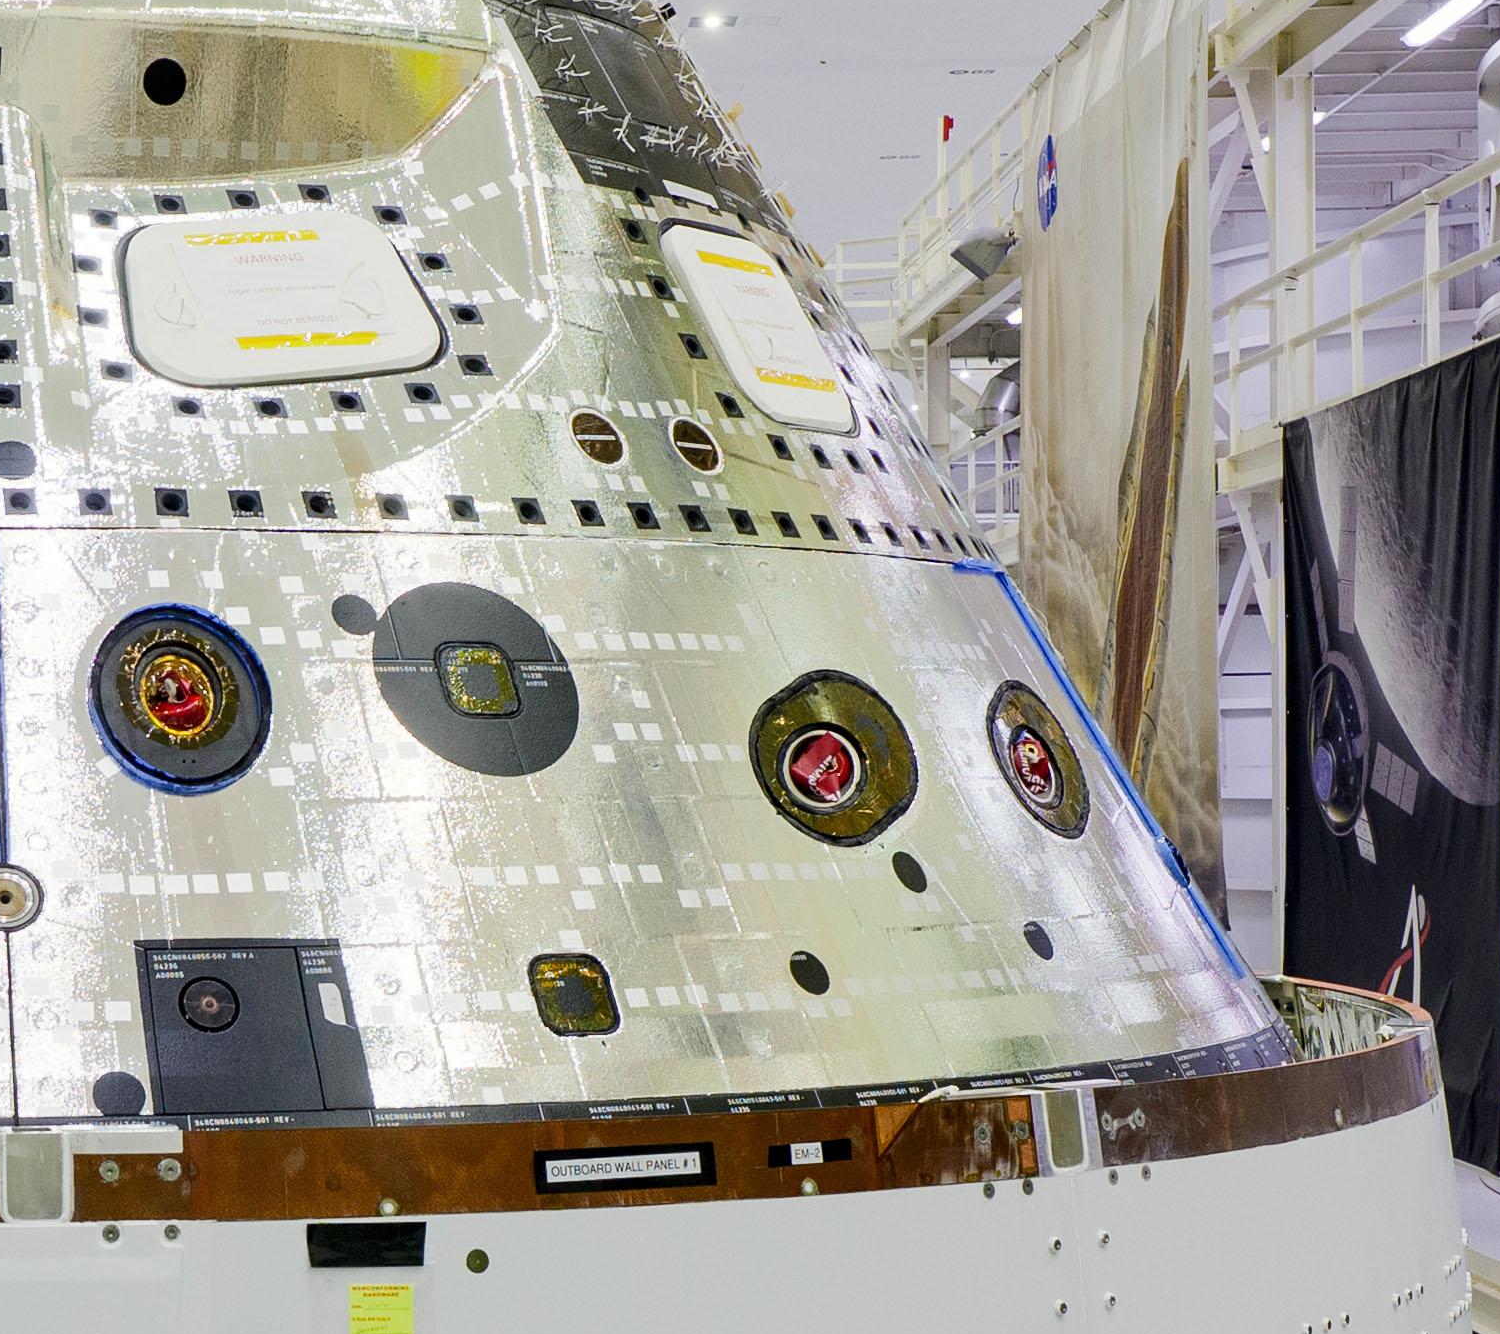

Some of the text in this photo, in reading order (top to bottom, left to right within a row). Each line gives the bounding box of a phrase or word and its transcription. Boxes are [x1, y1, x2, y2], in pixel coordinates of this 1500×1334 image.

[232, 252, 303, 265] WARNING
[795, 1148, 820, 1159] EM-2
[551, 1163, 612, 1177] OUTBOARD
[615, 1161, 643, 1173] WALL
[646, 1159, 680, 1171] PANEL
